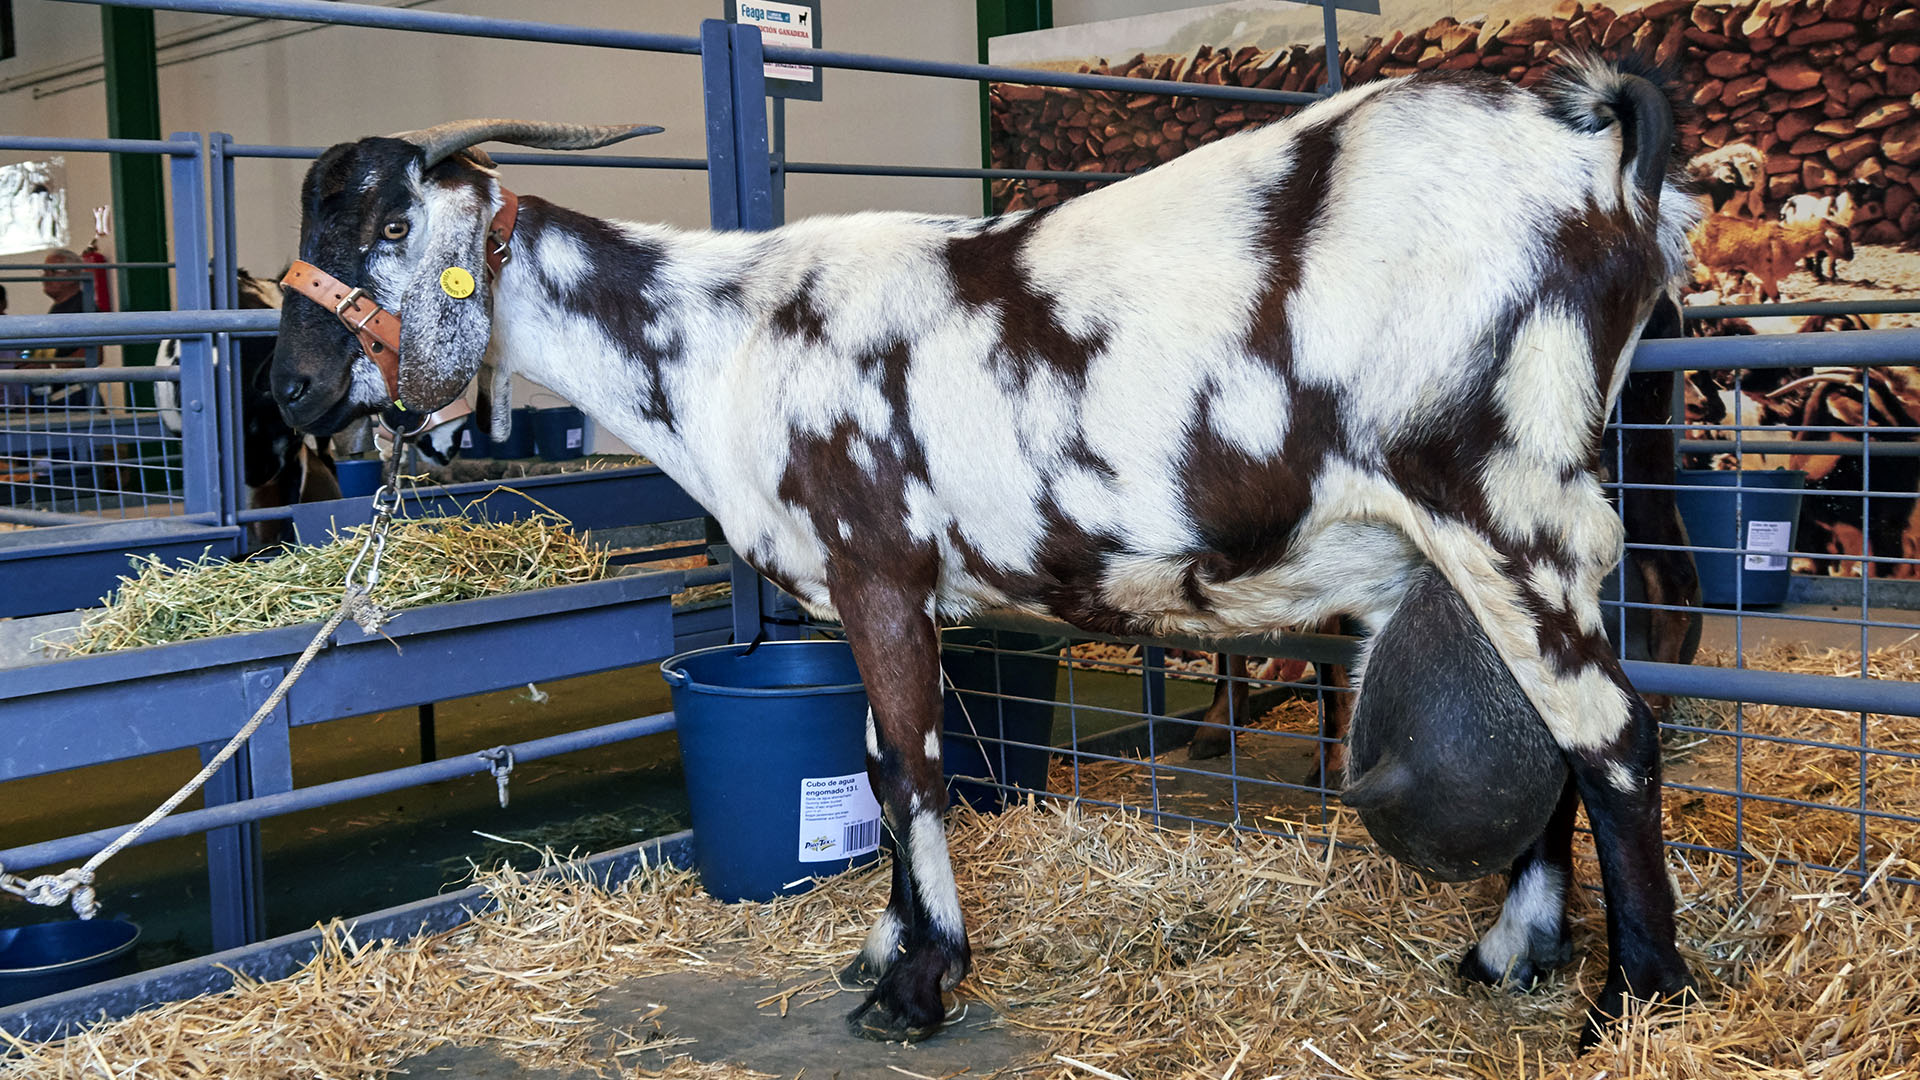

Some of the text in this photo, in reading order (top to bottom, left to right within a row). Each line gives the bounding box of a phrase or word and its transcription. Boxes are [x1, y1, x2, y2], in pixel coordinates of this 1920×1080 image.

[741, 3, 765, 21] Feaga
[778, 28, 809, 38] GANADERA
[838, 778, 855, 786] agua
[806, 788, 844, 796] engomado
